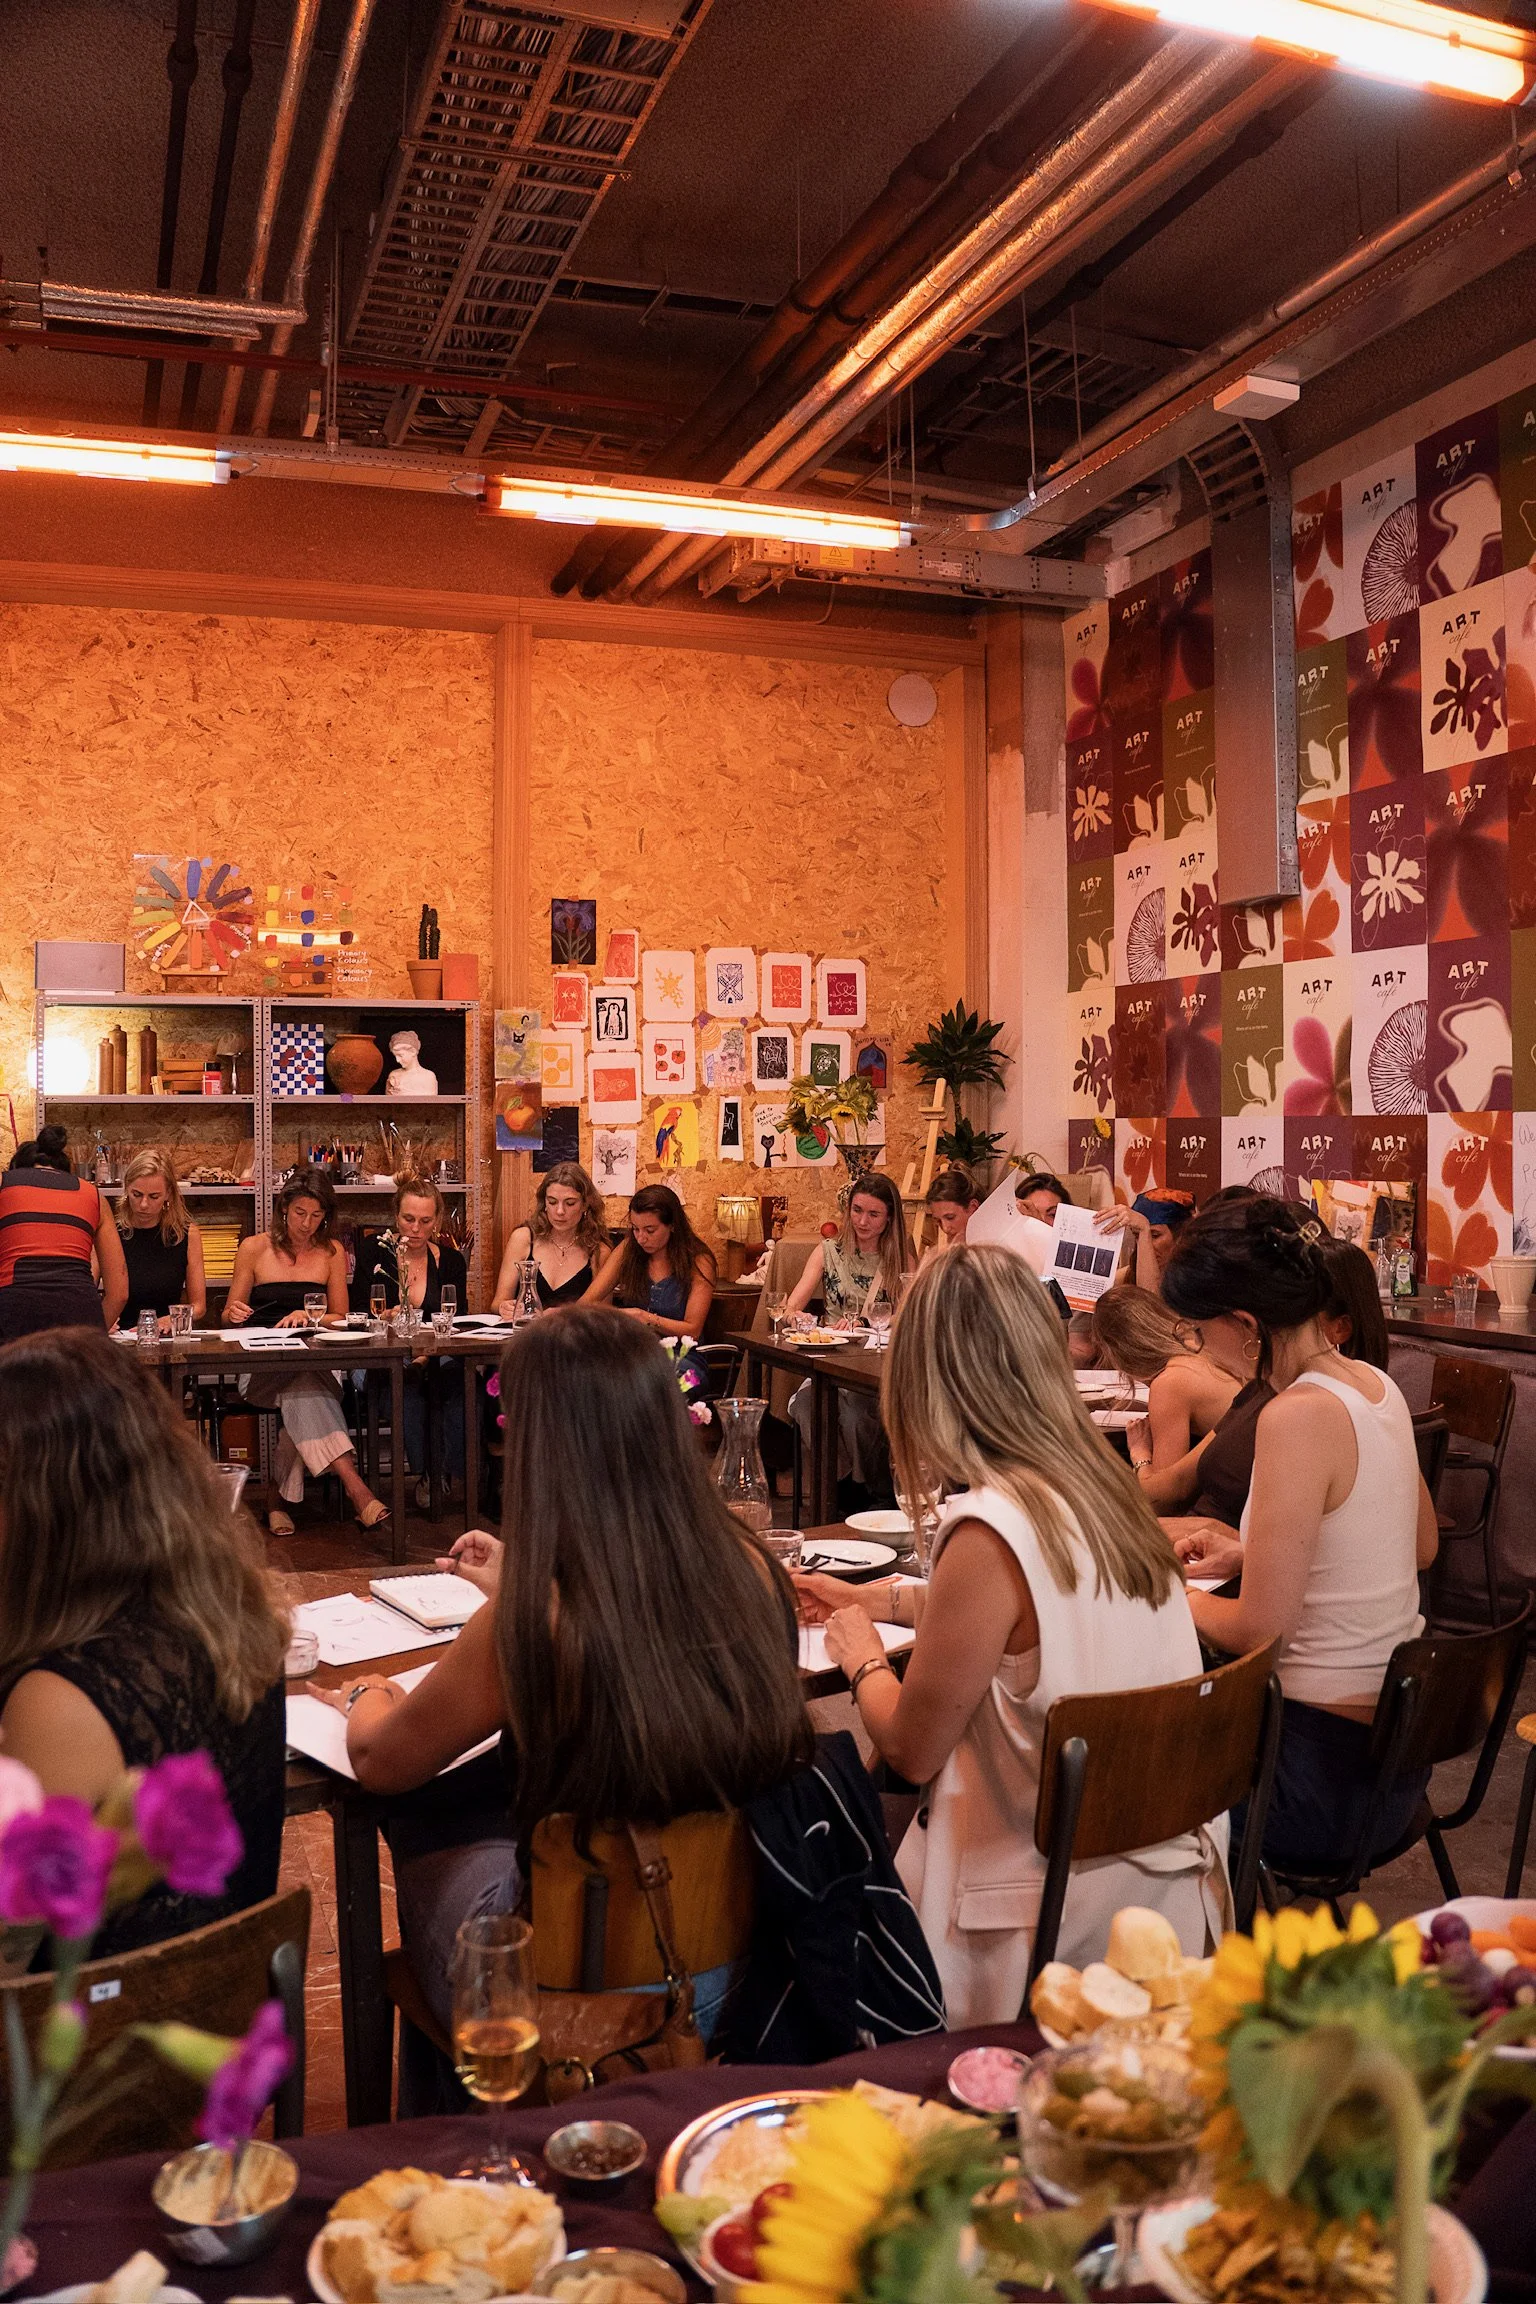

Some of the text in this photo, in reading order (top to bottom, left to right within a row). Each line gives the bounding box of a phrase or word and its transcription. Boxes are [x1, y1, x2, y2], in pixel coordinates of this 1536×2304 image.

[1436, 440, 1476, 469] ART
[1361, 478, 1396, 504] ART
[1292, 512, 1323, 536] ART
[1173, 572, 1200, 595] ART
[1122, 599, 1147, 620] ART
[1442, 610, 1480, 635] ART
[1076, 623, 1098, 643] ART
[1366, 639, 1400, 663] ART
[1297, 665, 1328, 687] ART
[1176, 710, 1203, 730] ART
[1125, 731, 1149, 749] ART
[1077, 748, 1100, 765] ART
[1446, 784, 1486, 806] ART
[1369, 804, 1404, 824] ART
[1453, 797, 1476, 828] café
[1297, 821, 1331, 839] ART
[1375, 816, 1396, 842] café
[1179, 852, 1205, 868] ART
[1127, 865, 1151, 881] ART
[1079, 876, 1101, 892] ART
[1371, 970, 1407, 987] ART
[1448, 960, 1489, 978] ART
[1237, 986, 1267, 1002] ART
[1301, 979, 1333, 995] ART
[1376, 981, 1397, 1008] café
[1454, 973, 1479, 1000] café
[1127, 1000, 1152, 1015] ART
[1180, 993, 1207, 1009] ART
[1080, 1006, 1102, 1020] ART
[1128, 1136, 1153, 1149] ART
[1180, 1135, 1207, 1150] ART
[1237, 1136, 1267, 1150] ART
[1301, 1135, 1333, 1150] ART
[1371, 1135, 1407, 1151] ART
[1450, 1135, 1489, 1152] ART
[1306, 1147, 1325, 1169] café
[1377, 1147, 1399, 1172] café
[1455, 1146, 1479, 1174] café
